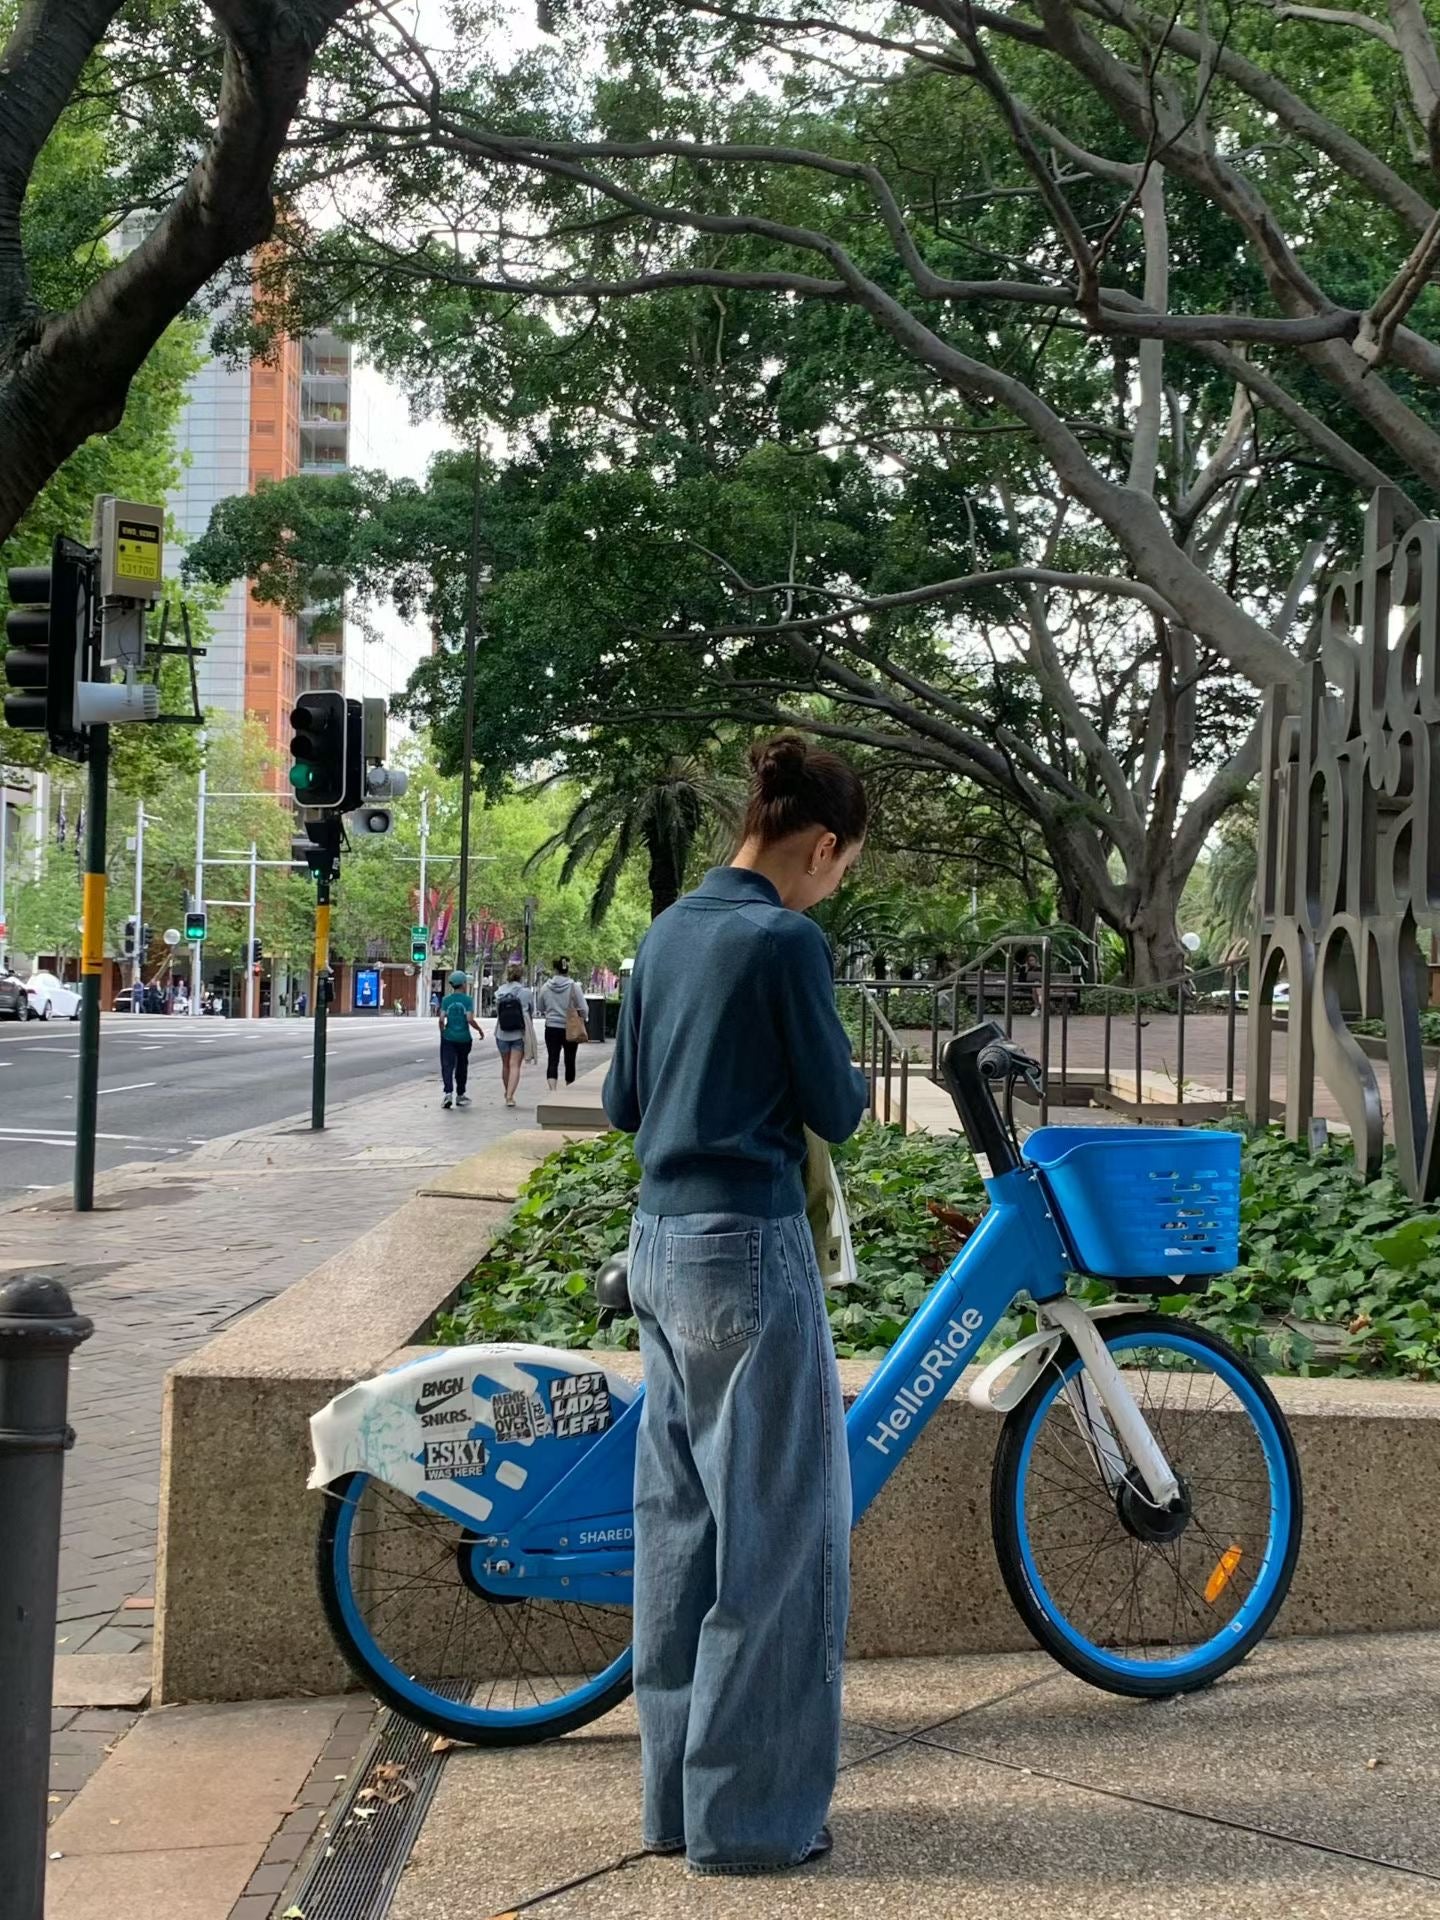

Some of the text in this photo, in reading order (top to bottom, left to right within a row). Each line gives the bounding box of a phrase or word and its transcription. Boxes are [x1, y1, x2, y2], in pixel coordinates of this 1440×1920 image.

[422, 1377, 464, 1398] BNGN
[551, 1374, 604, 1399] LAST
[866, 1308, 984, 1455] HelloRide
[553, 1392, 609, 1419] LADS
[556, 1411, 610, 1438] LEFT
[427, 1440, 483, 1467] ESKY
[428, 1466, 483, 1480] WAS HERE
[579, 1528, 633, 1545] SHARED
